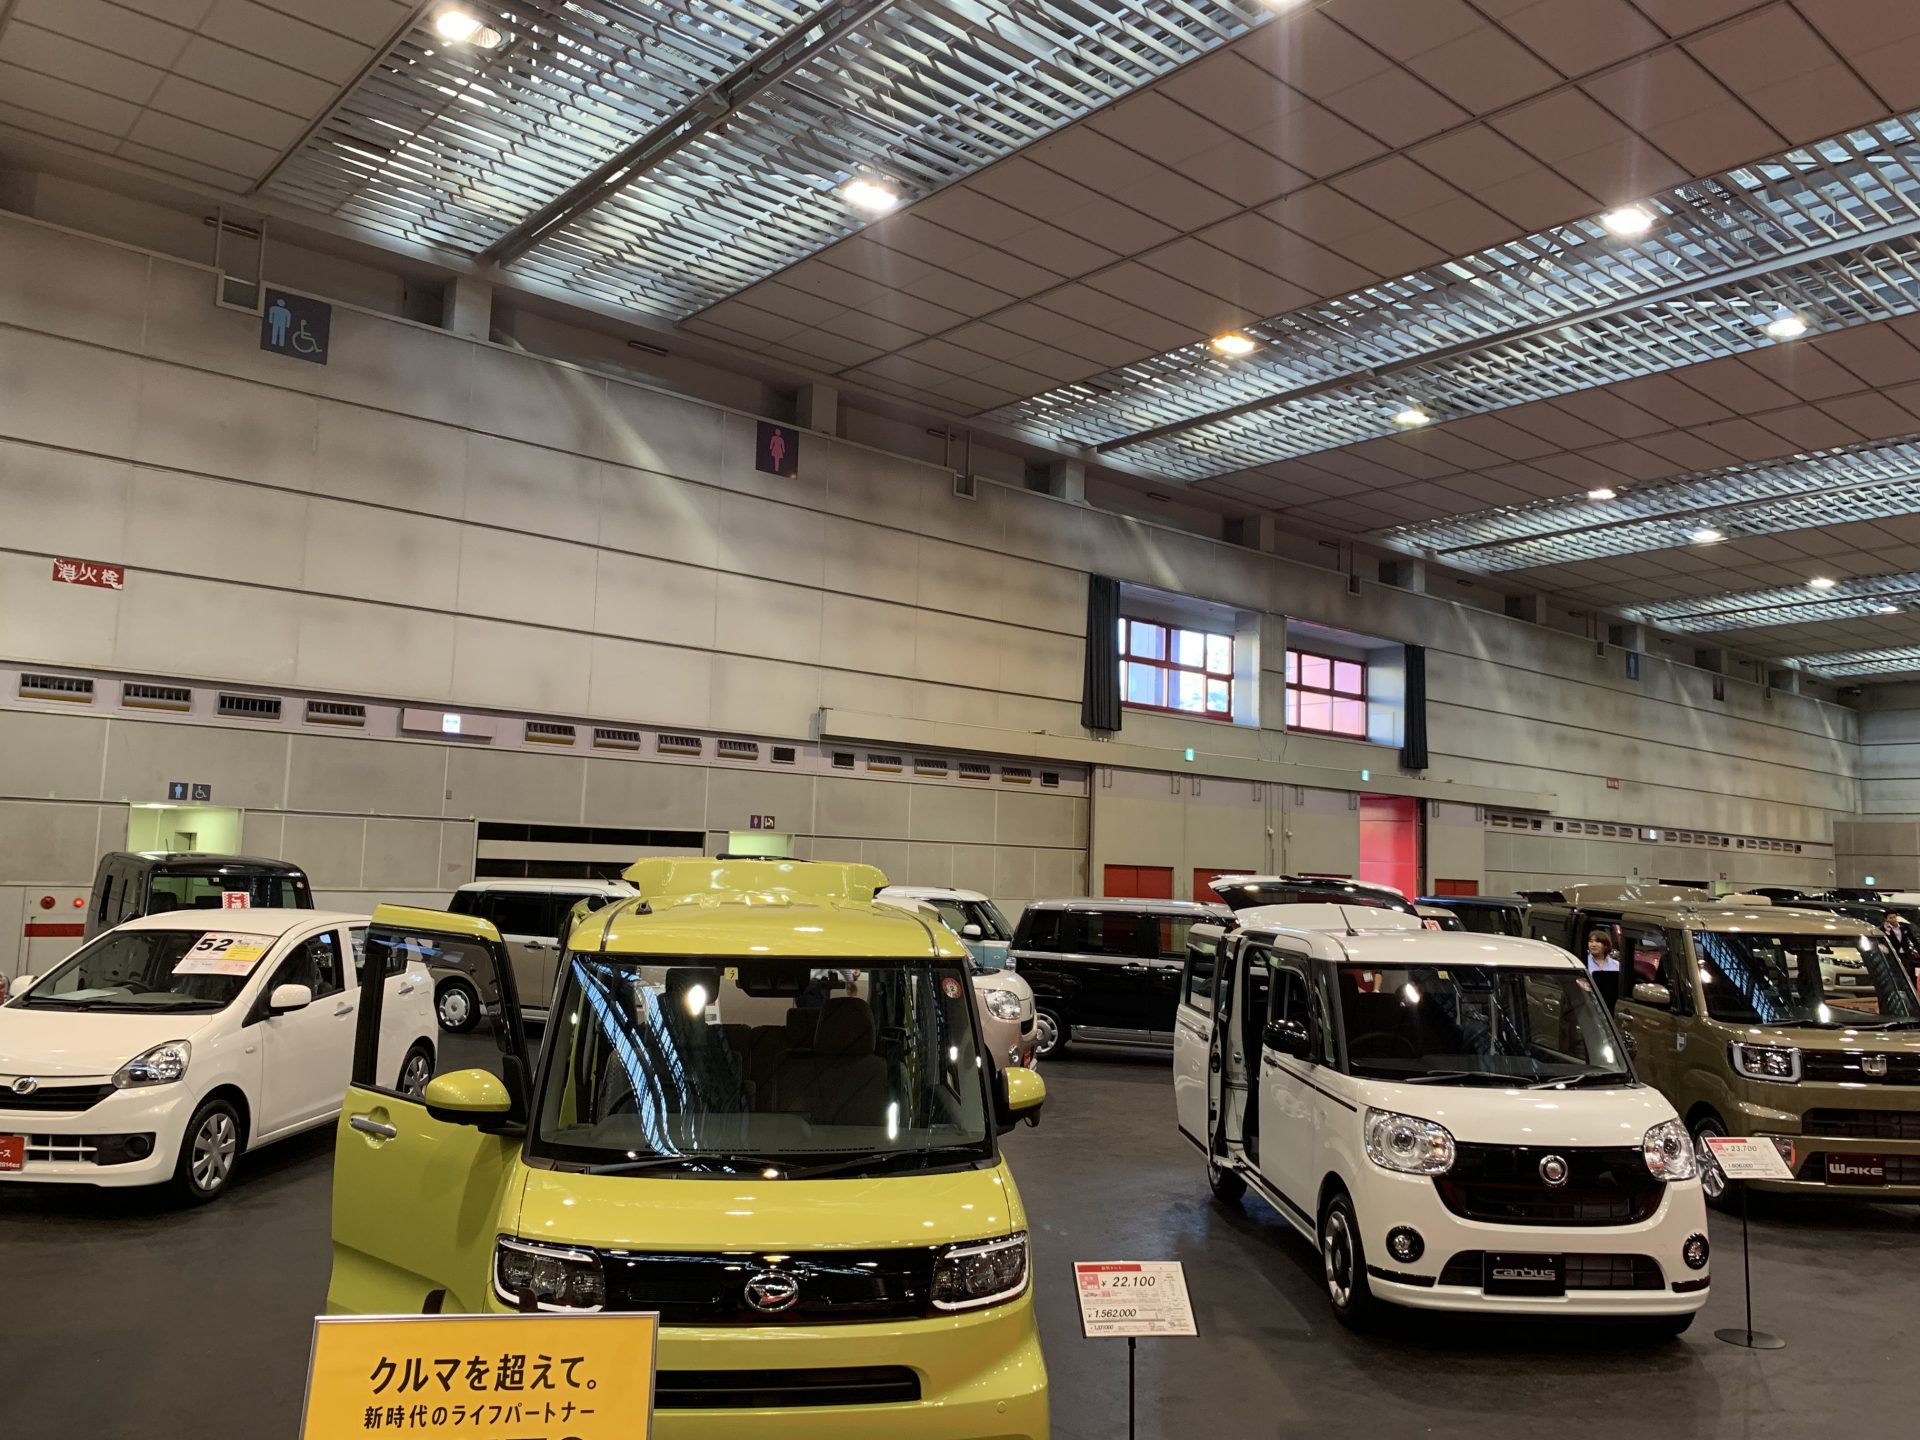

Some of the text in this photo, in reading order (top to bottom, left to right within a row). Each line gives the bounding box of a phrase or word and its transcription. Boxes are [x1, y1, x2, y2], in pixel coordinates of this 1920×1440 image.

[57, 563, 119, 585] 消火栓
[196, 938, 234, 952] 52
[369, 1353, 597, 1395] クルマを超えて。
[362, 1401, 596, 1430] 新時代のライフパートナー
